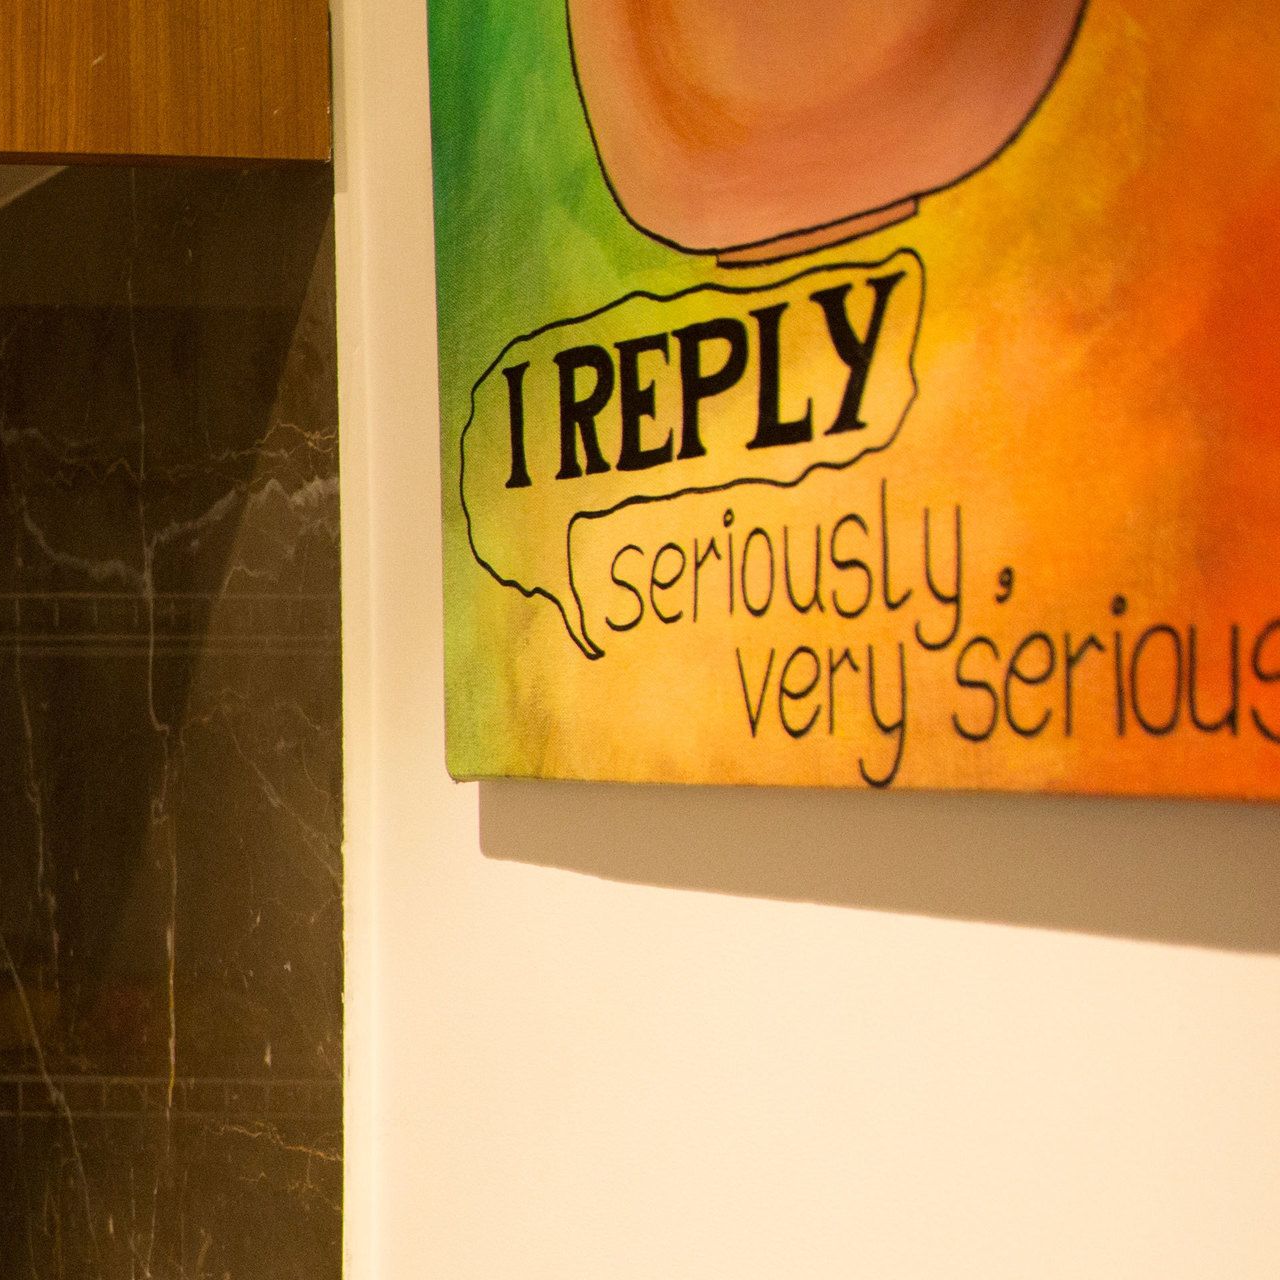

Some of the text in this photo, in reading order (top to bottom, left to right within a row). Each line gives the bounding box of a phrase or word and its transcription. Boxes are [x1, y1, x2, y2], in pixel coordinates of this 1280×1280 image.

[502, 271, 907, 490] I REPLY
[735, 641, 908, 789] very
